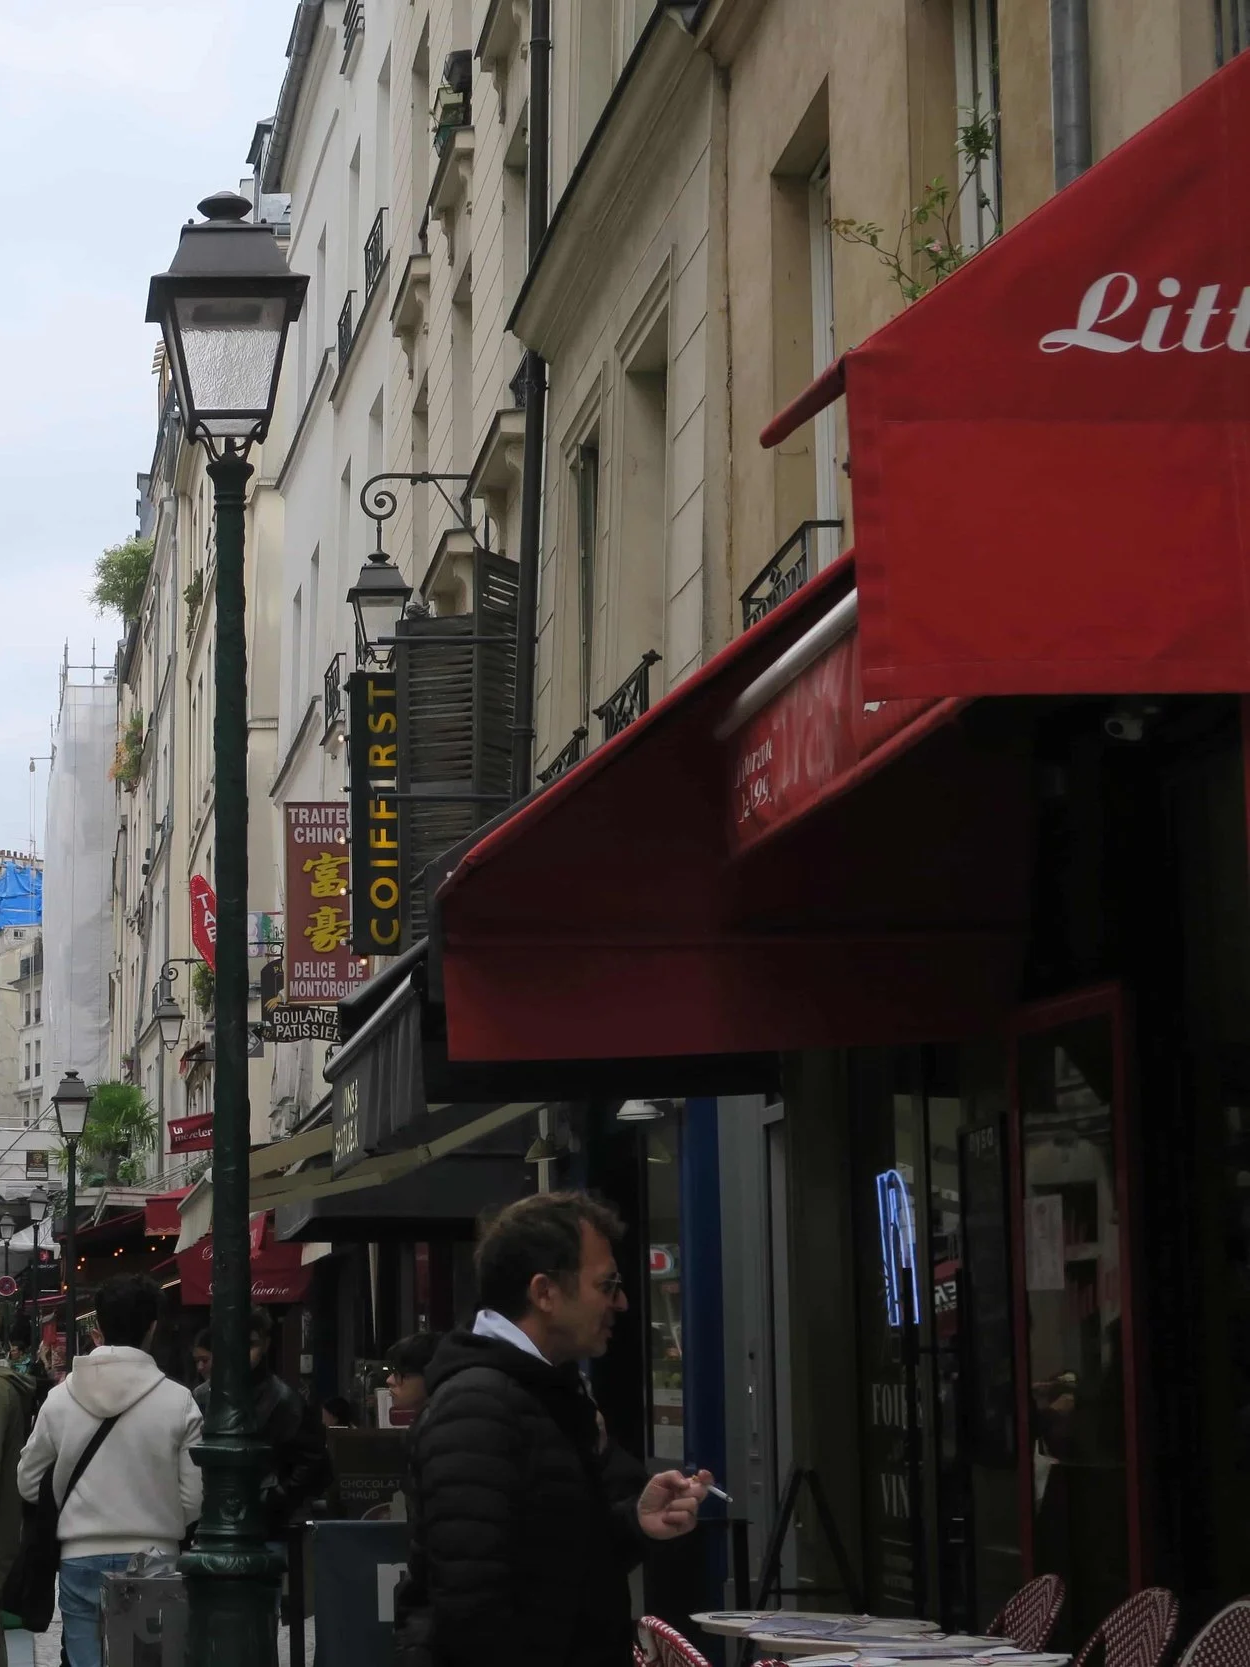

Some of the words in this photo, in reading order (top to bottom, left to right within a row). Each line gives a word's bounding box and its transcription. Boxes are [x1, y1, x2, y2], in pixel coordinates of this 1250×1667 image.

[294, 962, 336, 979] DELICE
[348, 961, 363, 978] DE
[289, 980, 362, 998] MONTORGUE
[340, 1479, 401, 1489] CHOCOLAT
[340, 1490, 380, 1500] CHAUD
